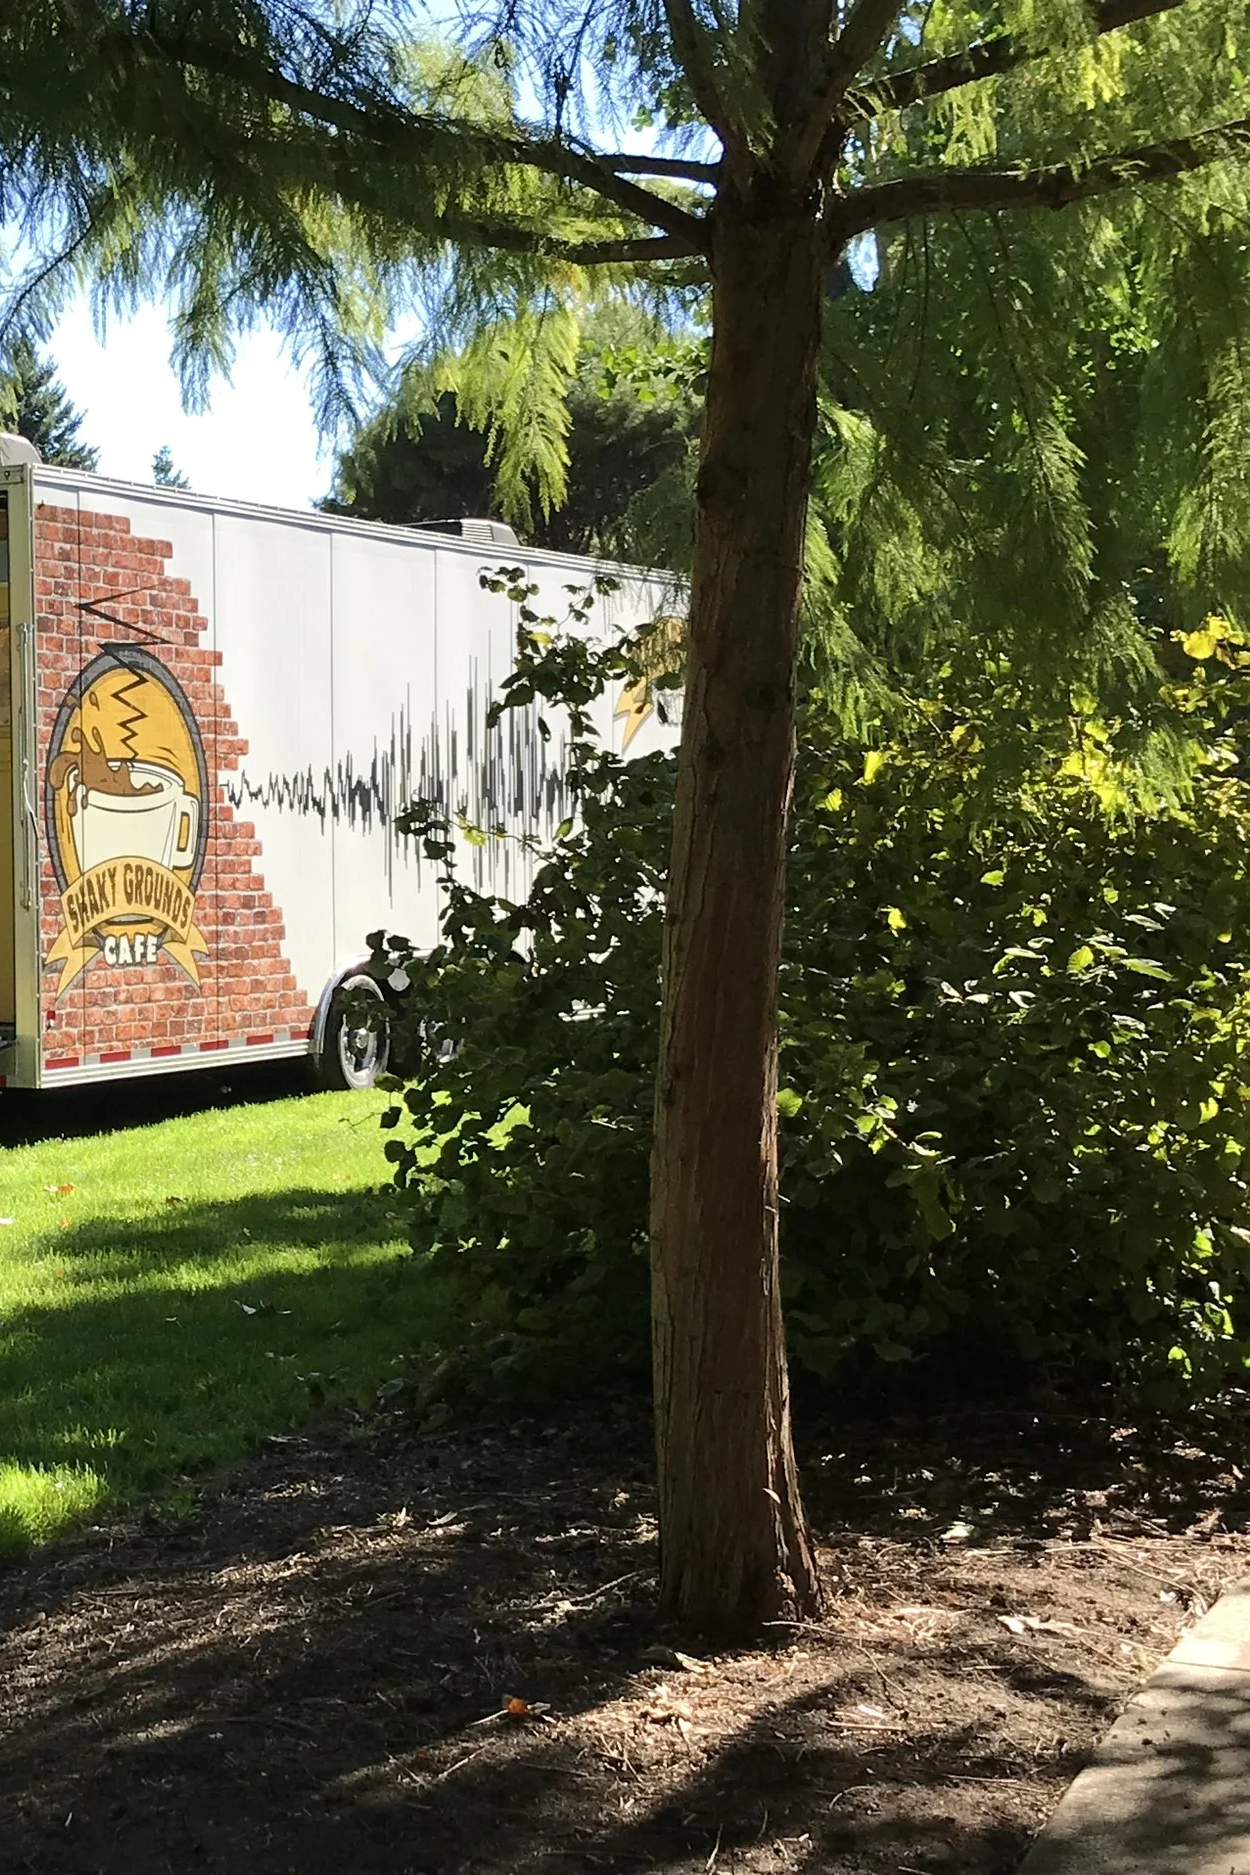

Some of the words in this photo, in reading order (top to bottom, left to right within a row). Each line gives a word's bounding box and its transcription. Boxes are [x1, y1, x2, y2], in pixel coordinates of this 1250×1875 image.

[66, 866, 117, 933] SHAKY
[123, 863, 191, 929] GROUNDS
[104, 935, 158, 965] CAFE
